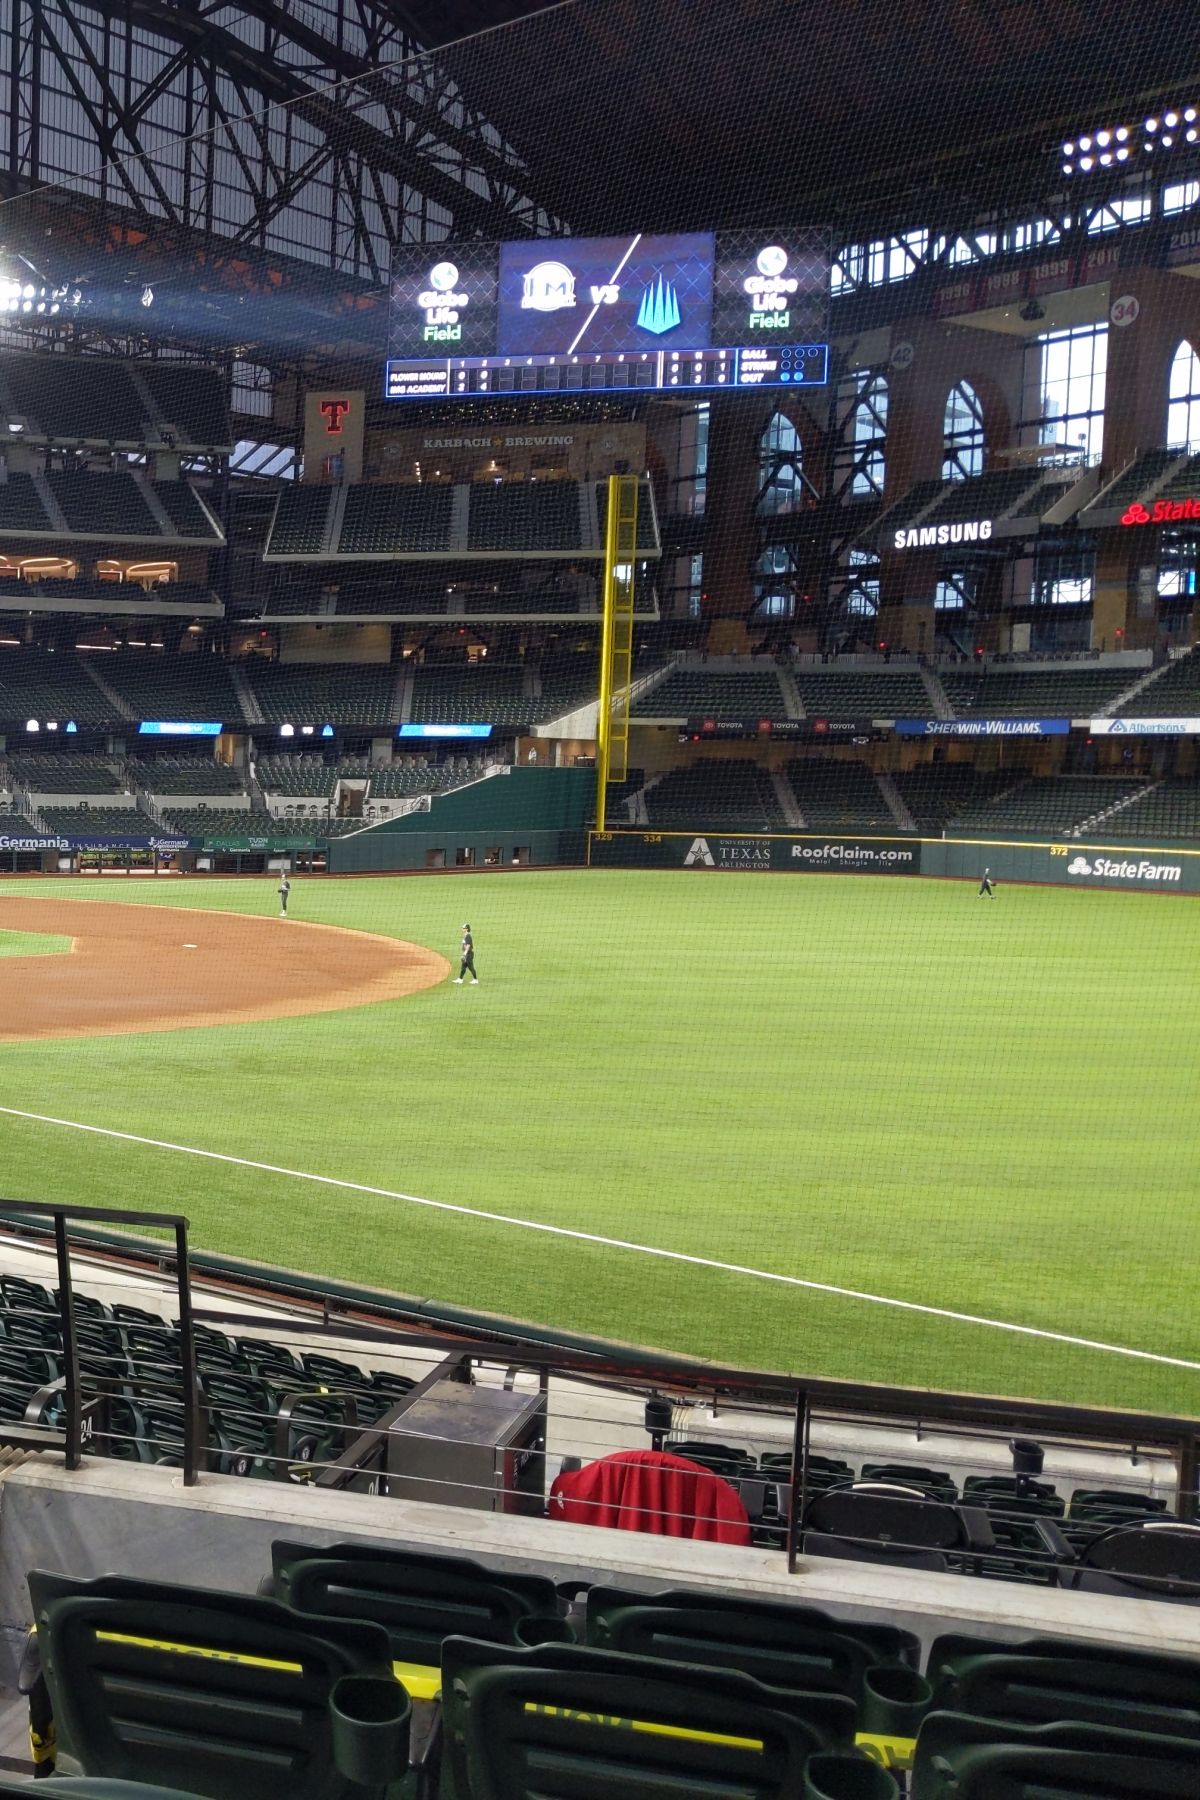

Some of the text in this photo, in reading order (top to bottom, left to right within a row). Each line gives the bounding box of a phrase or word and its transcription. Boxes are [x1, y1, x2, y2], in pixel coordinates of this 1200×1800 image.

[744, 276, 798, 294] Globe
[418, 291, 469, 308] Globe
[753, 293, 787, 311] Life
[427, 307, 459, 325] Life
[1114, 300, 1136, 321] 34
[750, 312, 789, 329] Field
[424, 325, 462, 341] Field
[505, 358, 510, 366] 3
[527, 357, 532, 365] 4
[741, 350, 767, 359] BALL
[459, 371, 465, 380] 0
[481, 370, 487, 379] 0
[672, 364, 678, 372] 0
[695, 363, 702, 372] 0
[741, 361, 777, 371] STRIKE
[406, 384, 446, 394] ACADEMY
[458, 383, 465, 391] 2
[480, 382, 488, 391] 4
[672, 376, 678, 384] 6
[694, 375, 701, 384] 3
[719, 374, 725, 383] 0
[741, 373, 764, 383] OUT
[320, 400, 350, 434] T
[424, 436, 574, 449] KARBACH BREWING
[1152, 499, 1200, 522] State
[895, 520, 992, 549] SAMSUNG
[1129, 721, 1186, 732] Albertsons
[159, 838, 188, 846] Germania
[644, 835, 662, 843] 334
[719, 848, 771, 860] TEXAS
[791, 844, 913, 862] RoofClaim.com
[1050, 847, 1068, 856] 372
[840, 859, 868, 867] Shingle
[81, 1416, 93, 1444] 24
